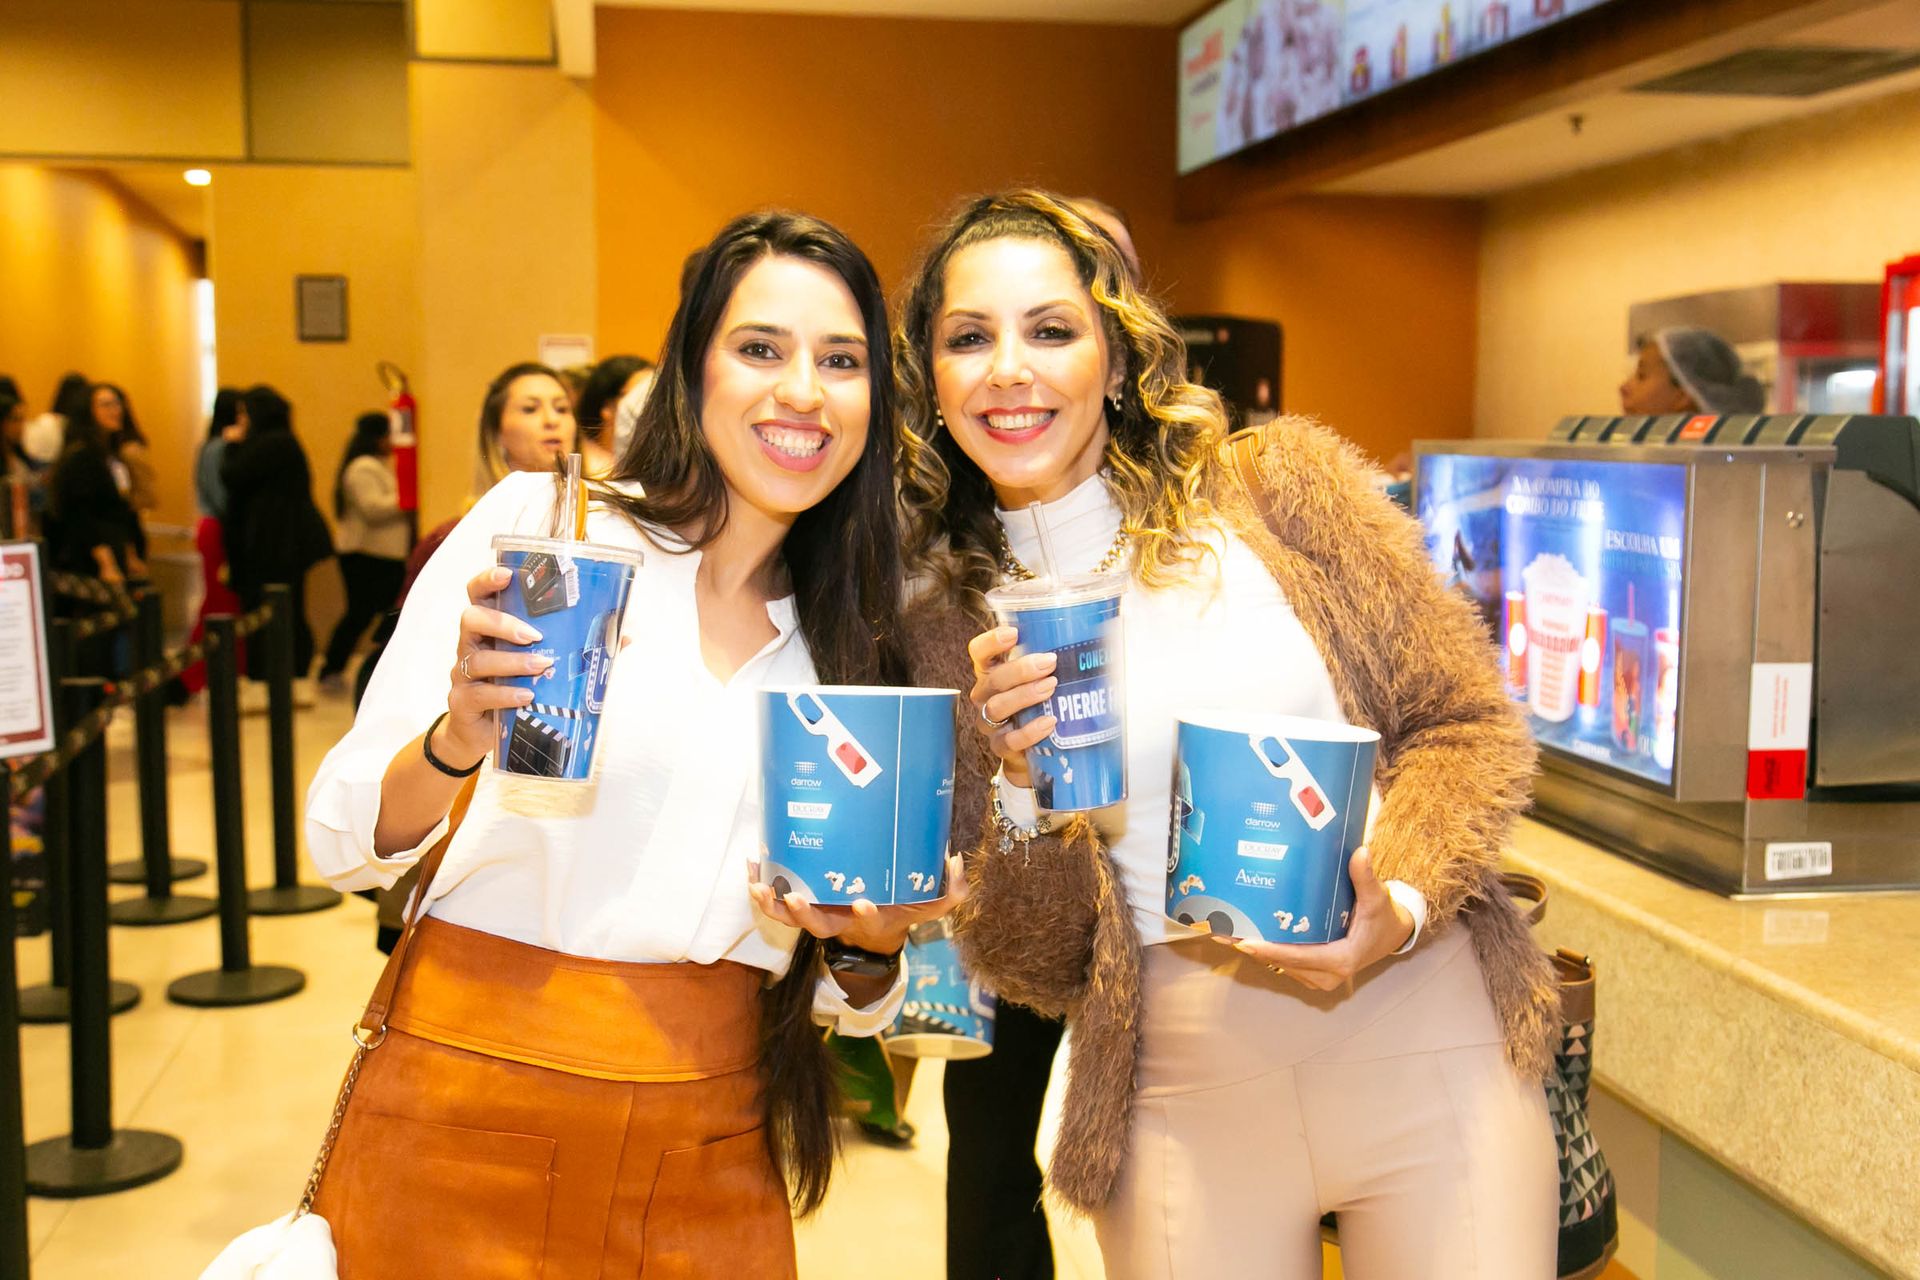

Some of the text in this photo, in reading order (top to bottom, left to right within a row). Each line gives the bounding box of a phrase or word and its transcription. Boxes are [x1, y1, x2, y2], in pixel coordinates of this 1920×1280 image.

[1057, 687, 1107, 722] PIERRE
[790, 777, 822, 787] darrow
[1244, 817, 1281, 829] darrow
[788, 830, 823, 847] Avène
[1235, 868, 1277, 887] Avène
